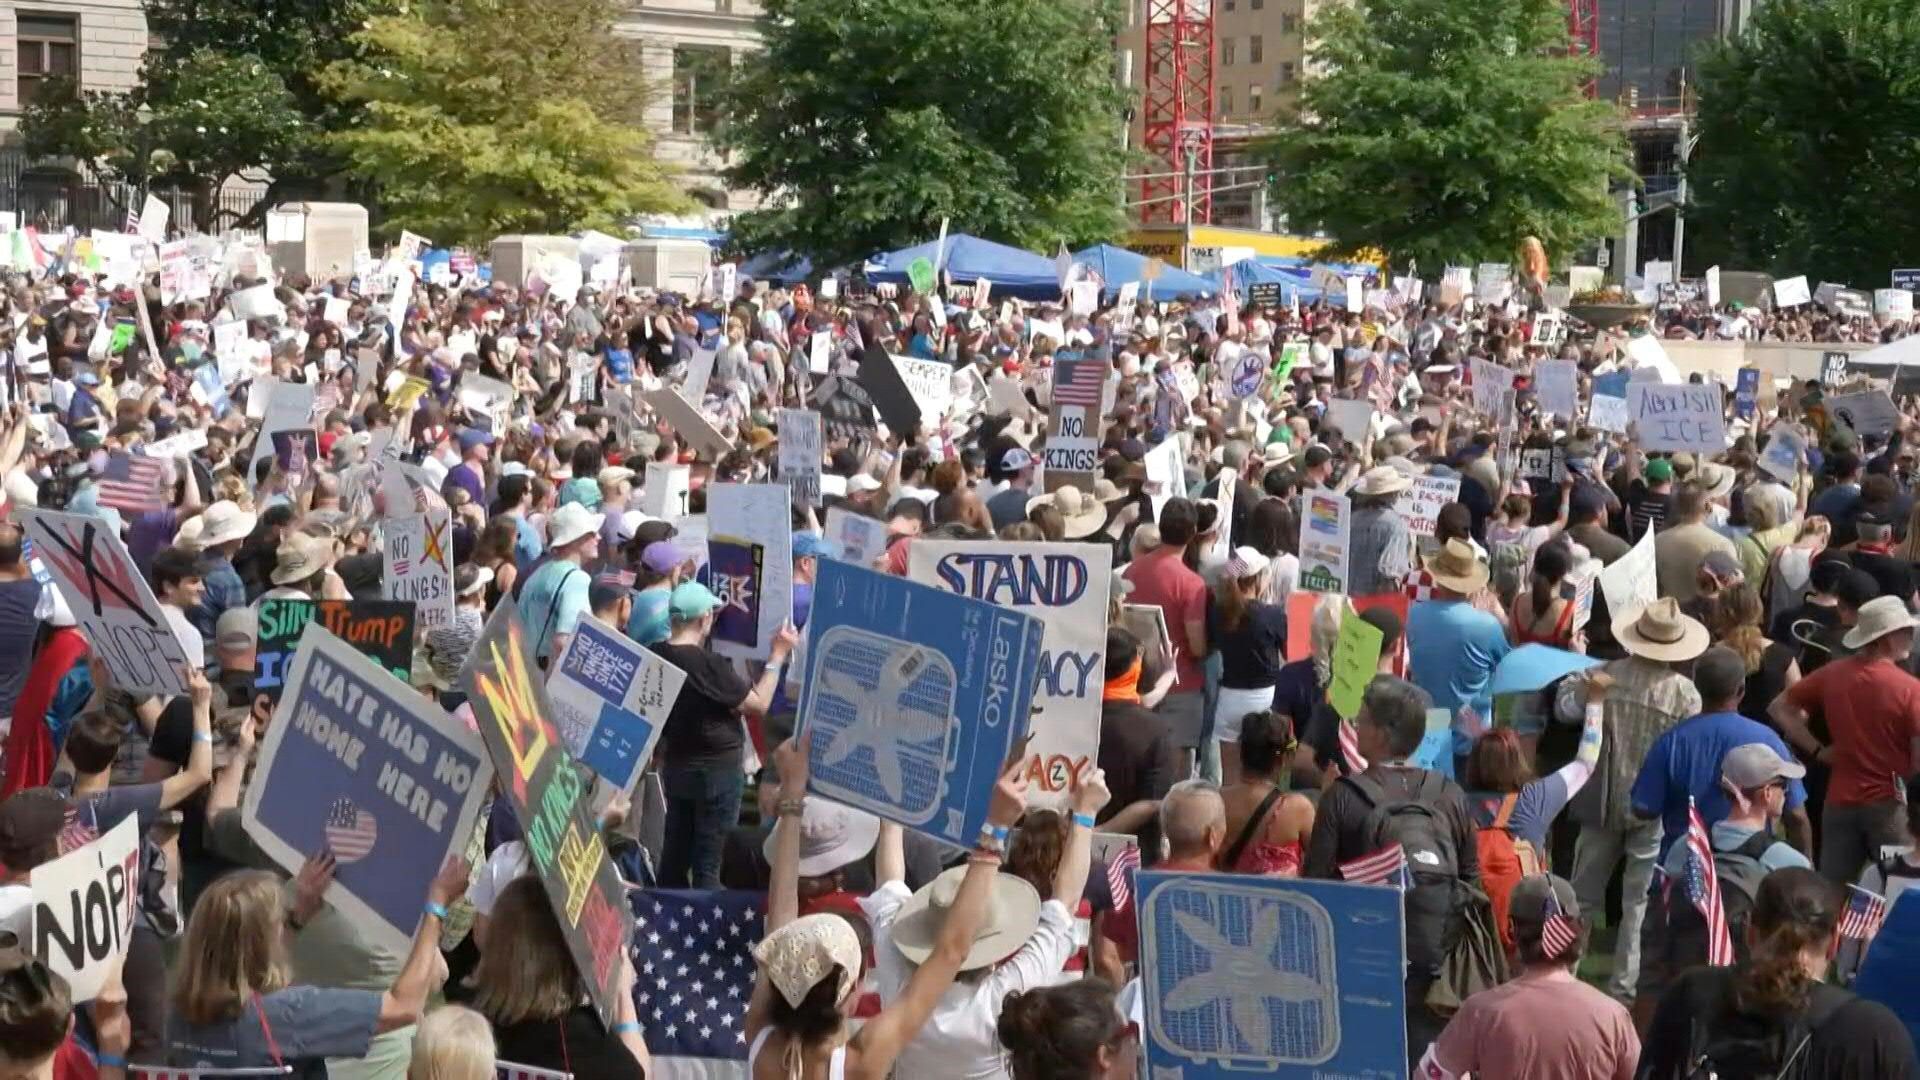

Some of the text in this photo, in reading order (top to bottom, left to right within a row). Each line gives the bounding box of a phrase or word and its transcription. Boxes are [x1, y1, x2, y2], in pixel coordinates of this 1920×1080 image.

[903, 360, 947, 380] SEMPER
[1061, 416, 1083, 437] NO
[1657, 417, 1712, 443] ICE
[1044, 449, 1095, 471] KINGS
[392, 534, 409, 560] NO
[392, 575, 449, 602] KINGS!!
[936, 552, 1088, 607] STAND
[258, 601, 406, 649] Silly Trump
[576, 632, 594, 656] NO
[84, 620, 191, 694] NOPE
[581, 641, 607, 680] KINGS
[594, 650, 619, 687] SINCE
[984, 615, 1019, 728] Lasko
[607, 658, 635, 696] 1776
[309, 656, 379, 728] HATE
[379, 710, 430, 765] HAS
[432, 751, 472, 795] NO
[295, 700, 367, 771] HOME
[376, 760, 449, 833] HERE
[527, 812, 554, 877] NO
